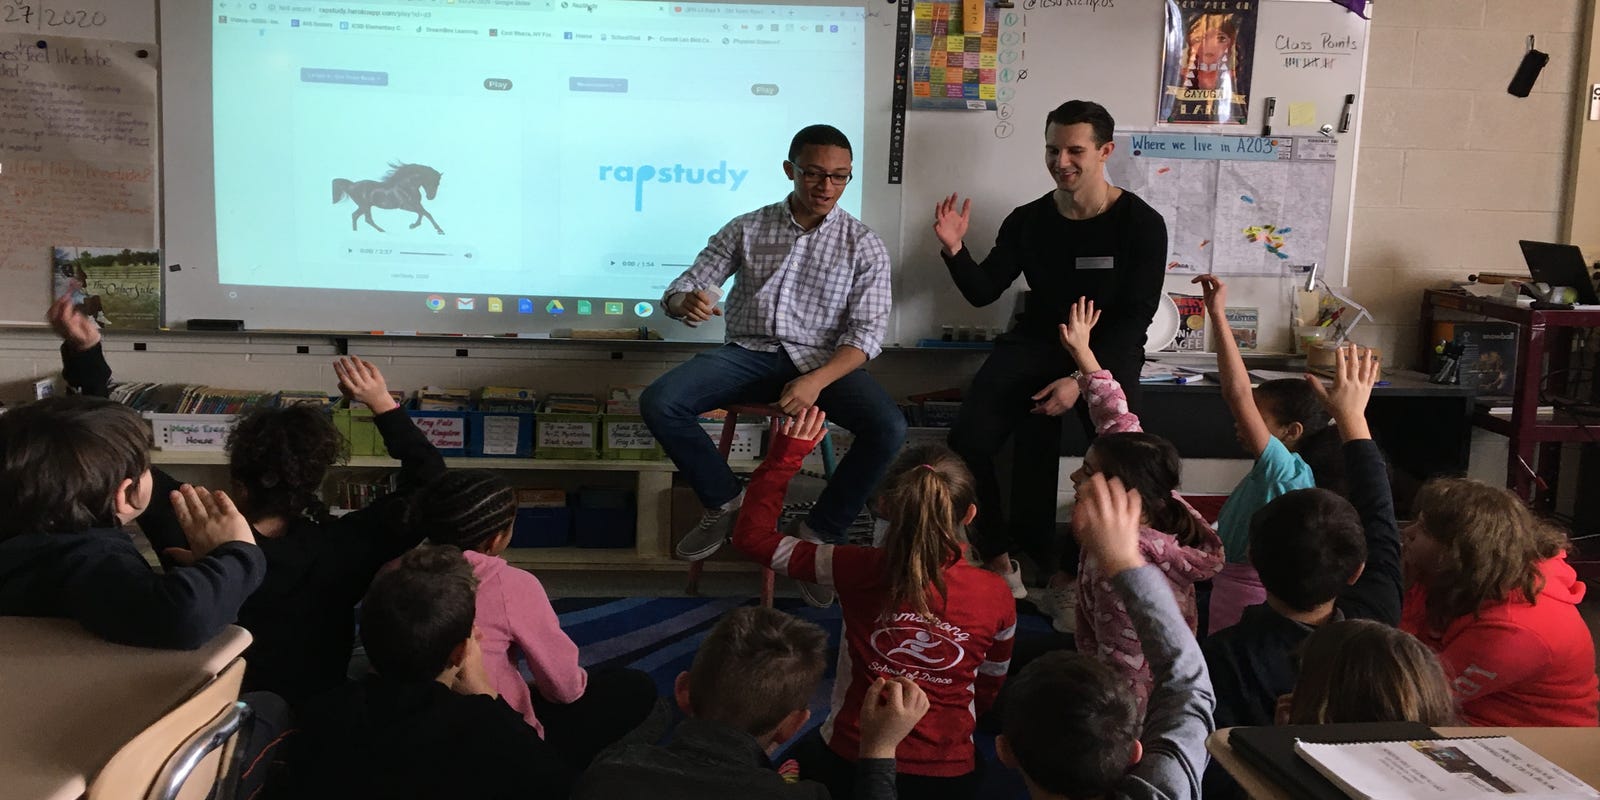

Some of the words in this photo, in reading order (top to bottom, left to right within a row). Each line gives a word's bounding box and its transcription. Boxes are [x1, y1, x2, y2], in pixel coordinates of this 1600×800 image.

[1275, 34, 1313, 50] Class
[1319, 32, 1358, 50] Points
[488, 80, 508, 90] Play
[755, 86, 775, 95] Play
[1132, 136, 1166, 151] Where
[1172, 141, 1186, 151] we
[1193, 136, 1213, 151] live
[1220, 143, 1231, 153] in
[1236, 137, 1273, 154] A203
[599, 160, 749, 212] rapstudy
[1171, 338, 1204, 350] AGEE
[868, 661, 907, 676] School
[905, 670, 920, 682] of
[919, 672, 953, 685] Dance
